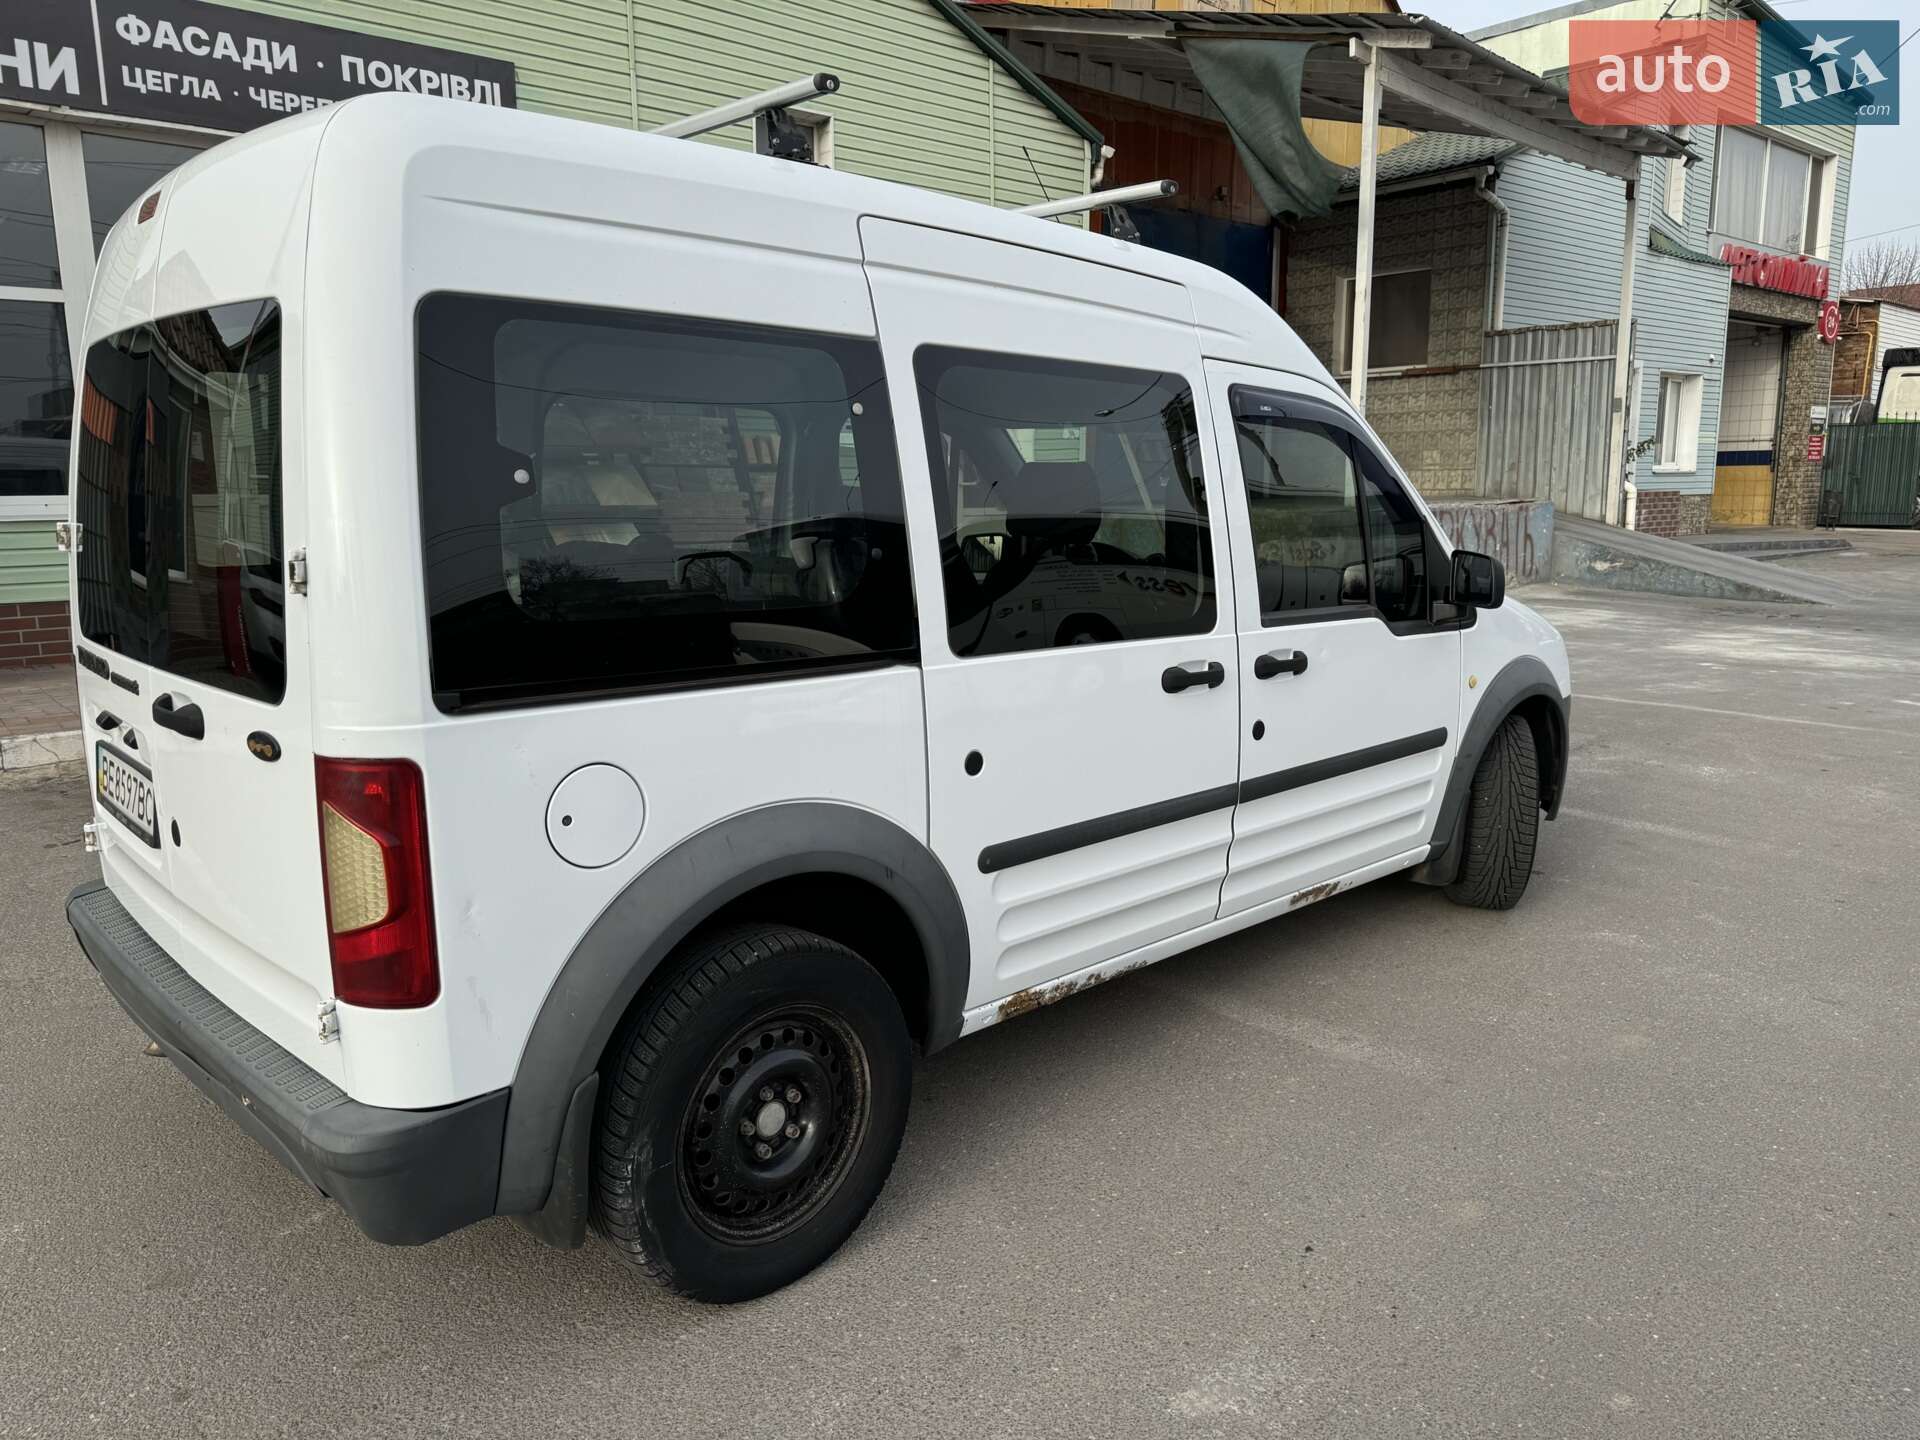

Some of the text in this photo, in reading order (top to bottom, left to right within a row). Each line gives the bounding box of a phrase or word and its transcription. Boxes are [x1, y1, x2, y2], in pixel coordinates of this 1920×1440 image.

[115, 13, 503, 107] ФАСАДИ ПОКРІВЛІ
[121, 64, 337, 113] ЦЕГЛА ЧЕРЕ
[102, 755, 153, 826] BE8597BC
